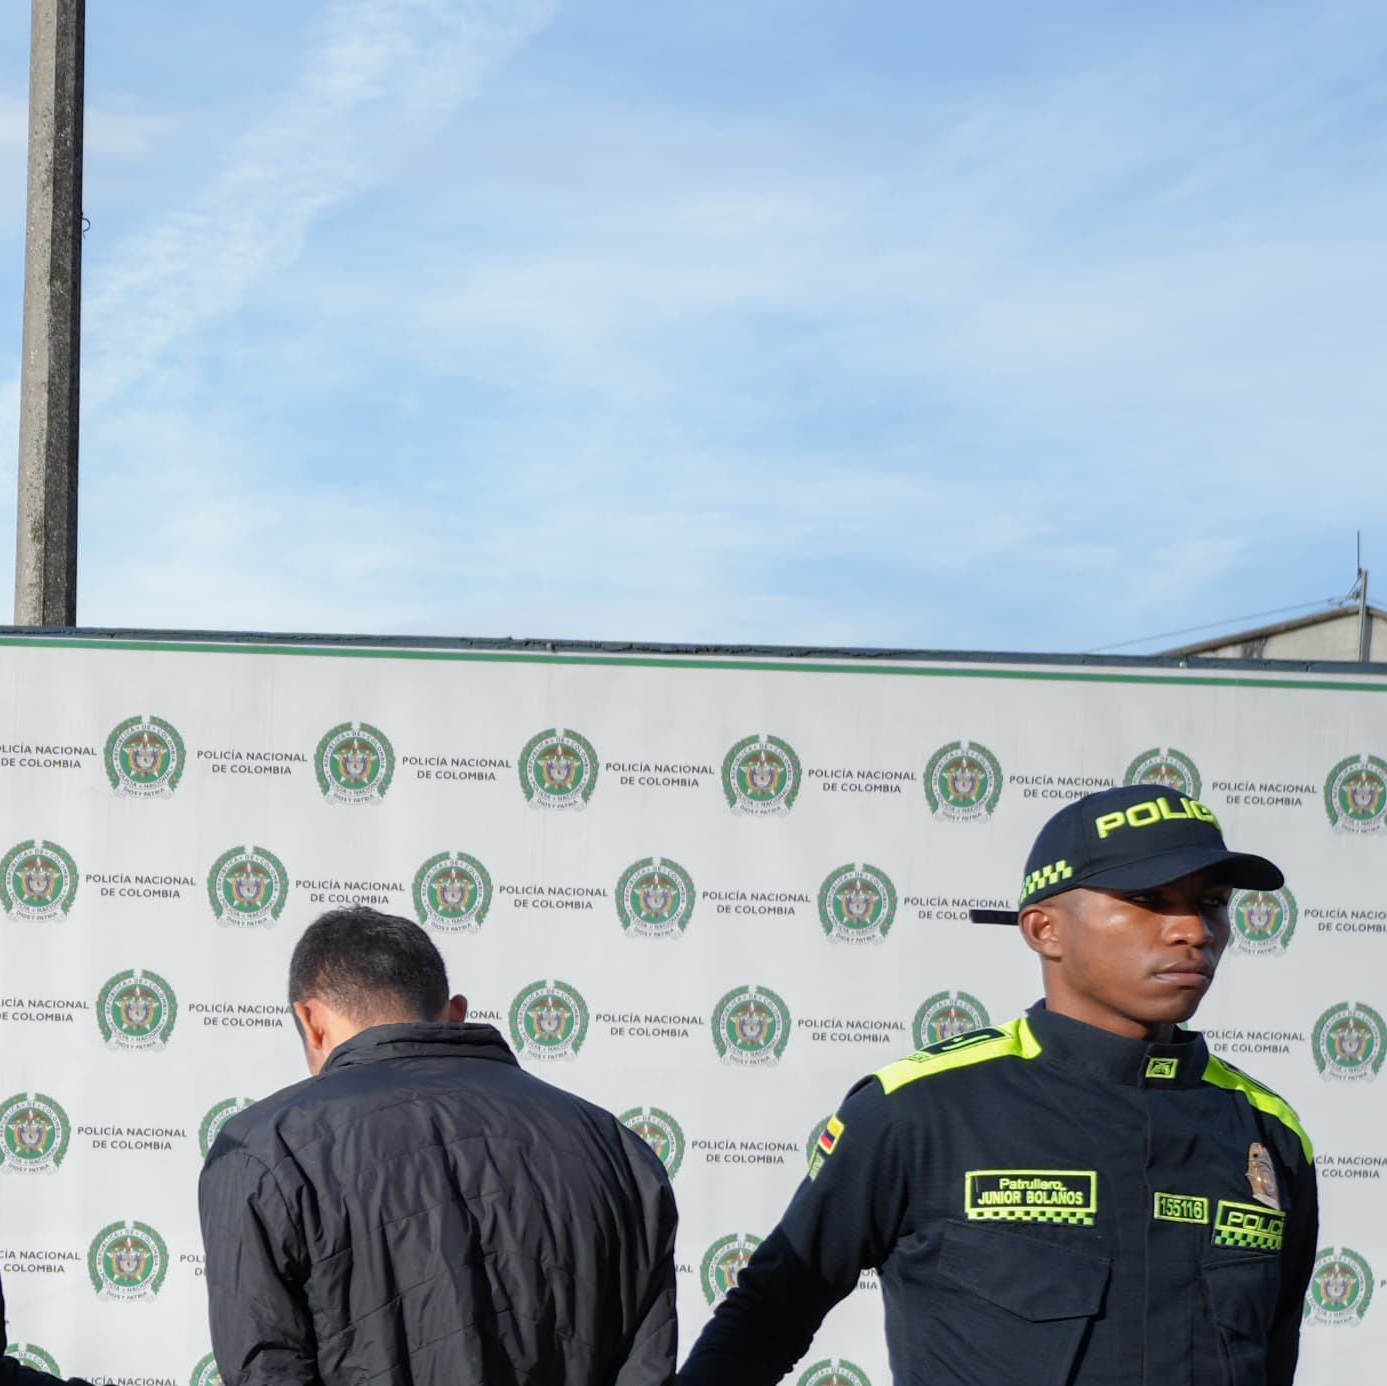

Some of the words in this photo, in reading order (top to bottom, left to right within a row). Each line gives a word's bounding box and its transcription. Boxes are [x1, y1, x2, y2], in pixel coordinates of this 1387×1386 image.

[34, 744, 98, 757] NACIONAL
[0, 756, 16, 768] DE
[18, 757, 82, 769] COLOMBIA
[401, 754, 449, 768] POLICÍA
[450, 757, 512, 769] NACIONAL
[416, 769, 433, 780] DE
[434, 769, 497, 782] COLOMBIA
[807, 767, 854, 780] POLICÍA
[856, 769, 918, 782] NACIONAL
[822, 781, 838, 792] DE
[840, 782, 902, 794] COLOMBIA
[1211, 780, 1257, 793] POLICÍA
[1258, 783, 1318, 794] NACIONAL
[1225, 794, 1241, 805] DE
[1243, 794, 1303, 807] COLOMBIA
[1094, 796, 1223, 840] POLIC
[498, 883, 546, 897] POLICÍA
[546, 886, 609, 898] NACIONAL
[513, 898, 530, 909] DE
[531, 897, 594, 911] COLOMBIA
[595, 1012, 642, 1024] POLICÍA
[643, 1014, 705, 1026] NACIONAL
[610, 1026, 626, 1037] DE
[627, 1026, 690, 1038] COLOMBIA
[77, 1124, 124, 1137] POLICÍA
[125, 1127, 188, 1139] NACIONAL
[91, 1139, 108, 1150] DE
[109, 1139, 172, 1151] COLOMBIA
[998, 1177, 1063, 1191] Patrullero
[977, 1190, 1023, 1206] JUNIOR
[1159, 1196, 1204, 1220] 155116
